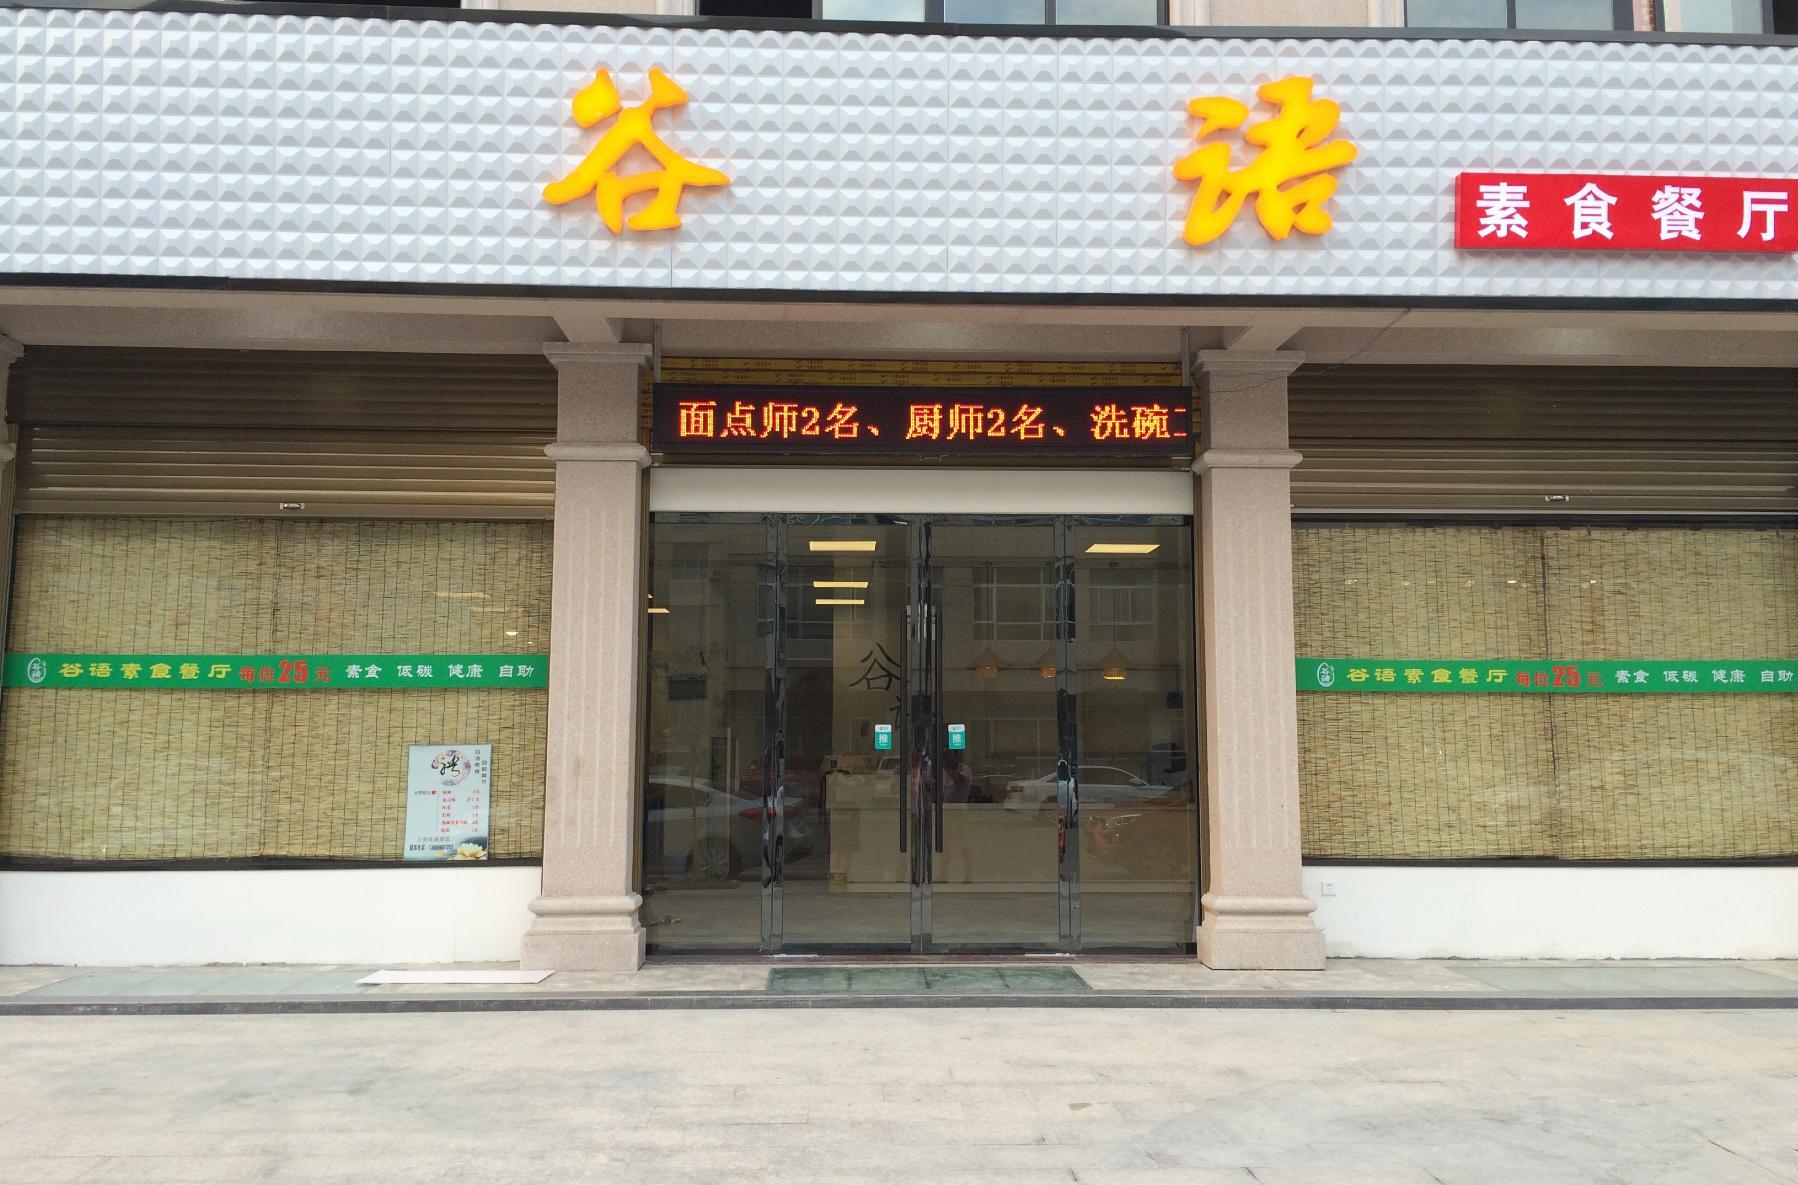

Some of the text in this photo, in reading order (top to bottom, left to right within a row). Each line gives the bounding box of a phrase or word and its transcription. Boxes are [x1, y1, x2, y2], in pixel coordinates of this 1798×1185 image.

[1475, 181, 1790, 242] 素食餐厅
[59, 660, 534, 684] 谷语素食餐厅 每位25元 素食 低碳 健康 自助
[1347, 665, 1794, 688] 谷语素食餐厅 每位25元 素食 低碳 健康 自助
